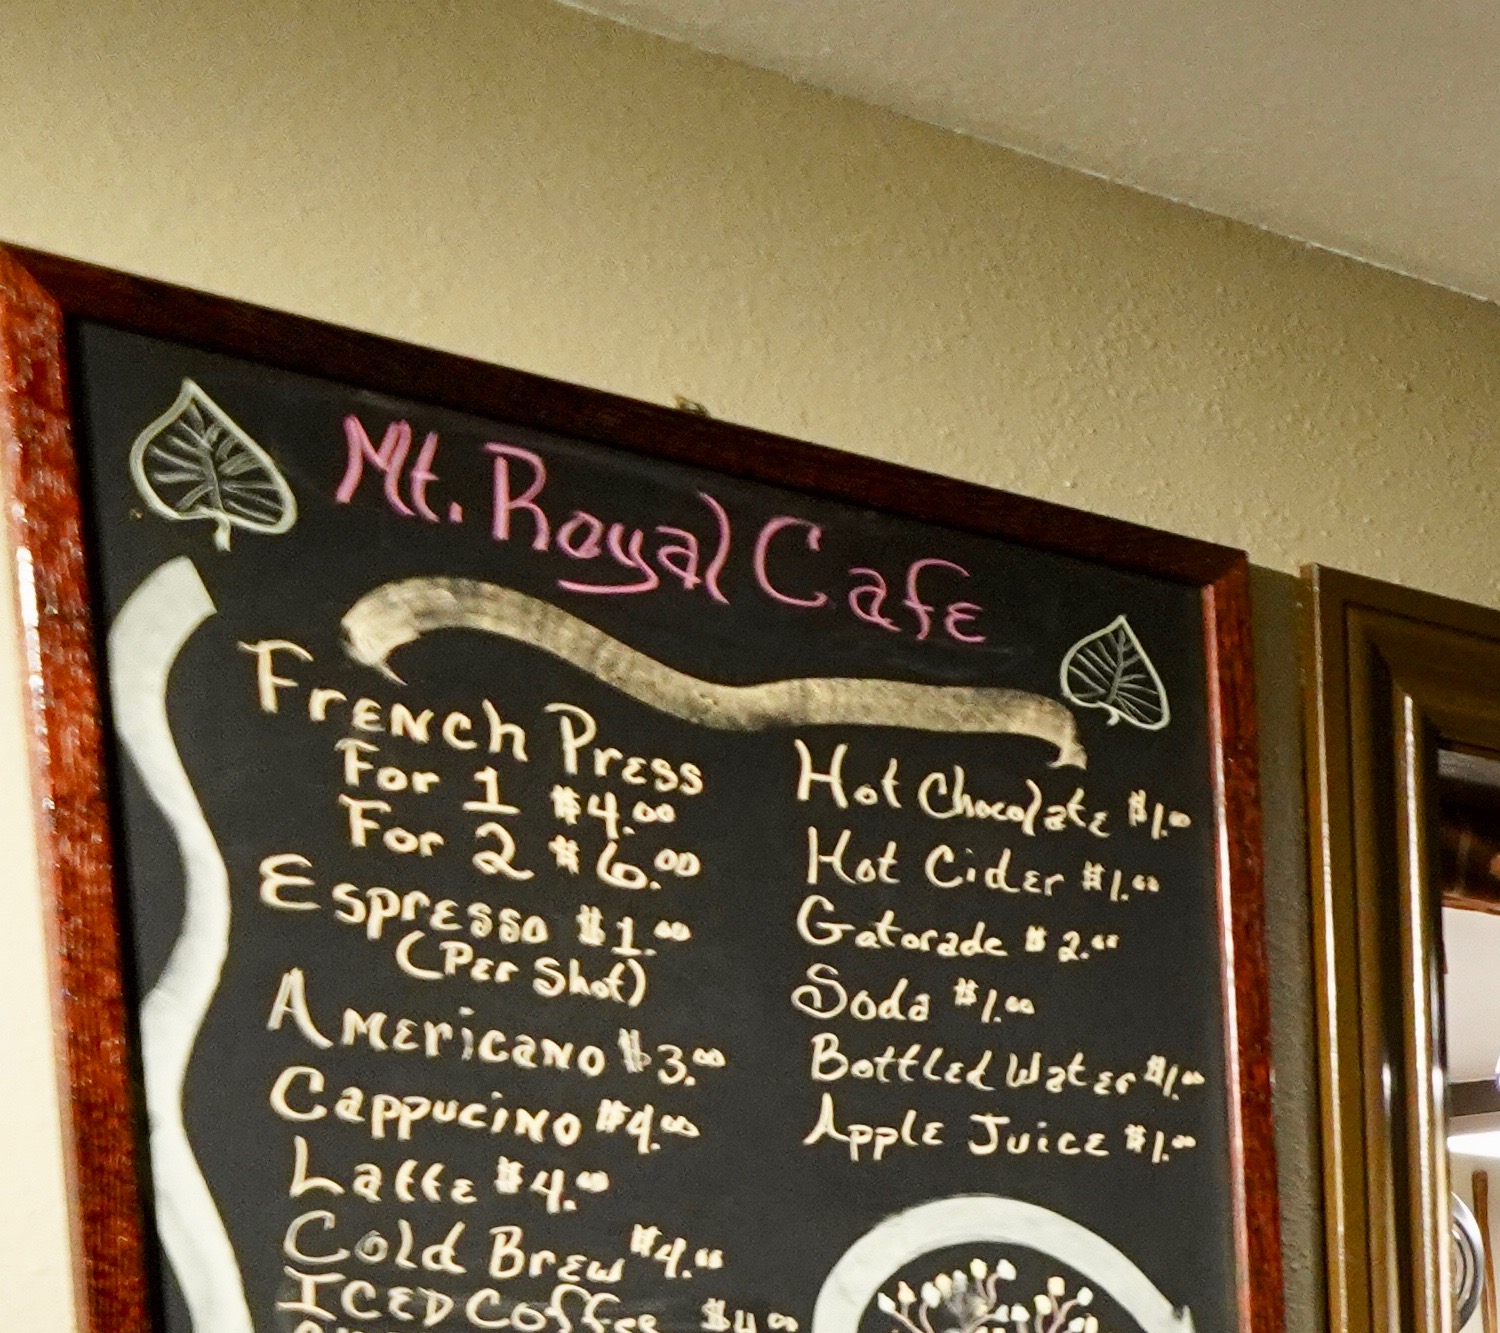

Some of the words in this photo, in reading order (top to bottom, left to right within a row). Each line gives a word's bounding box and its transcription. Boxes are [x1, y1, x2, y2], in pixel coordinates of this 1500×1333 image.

[336, 414, 464, 524] Mt.
[484, 442, 730, 604] Royal
[754, 516, 986, 643] Cafe
[335, 737, 440, 793] For
[462, 767, 519, 816] 1
[552, 784, 676, 839] $4.00
[545, 703, 704, 795] Press
[795, 740, 902, 808] Hot
[919, 766, 1110, 837] Chocolate
[339, 795, 444, 857] For
[473, 823, 533, 880] 2
[550, 837, 700, 891] $6.00
[808, 826, 900, 887] Hot
[925, 845, 1064, 894] Cider
[258, 852, 549, 939] Espresso
[797, 894, 1008, 957] Gatorade
[397, 930, 519, 980] (Per
[533, 957, 646, 1007] Shot)
[791, 963, 930, 1021] Soda
[267, 967, 606, 1078] Americano
[810, 1032, 996, 1091] Bottled
[1007, 1051, 1137, 1095] Water
[269, 1065, 581, 1147] Cappucino
[803, 1092, 944, 1162] Apple
[968, 1113, 1109, 1157] Juice
[289, 1135, 477, 1203] Latte
[282, 1210, 467, 1275] Cold
[488, 1225, 626, 1284] Brew
